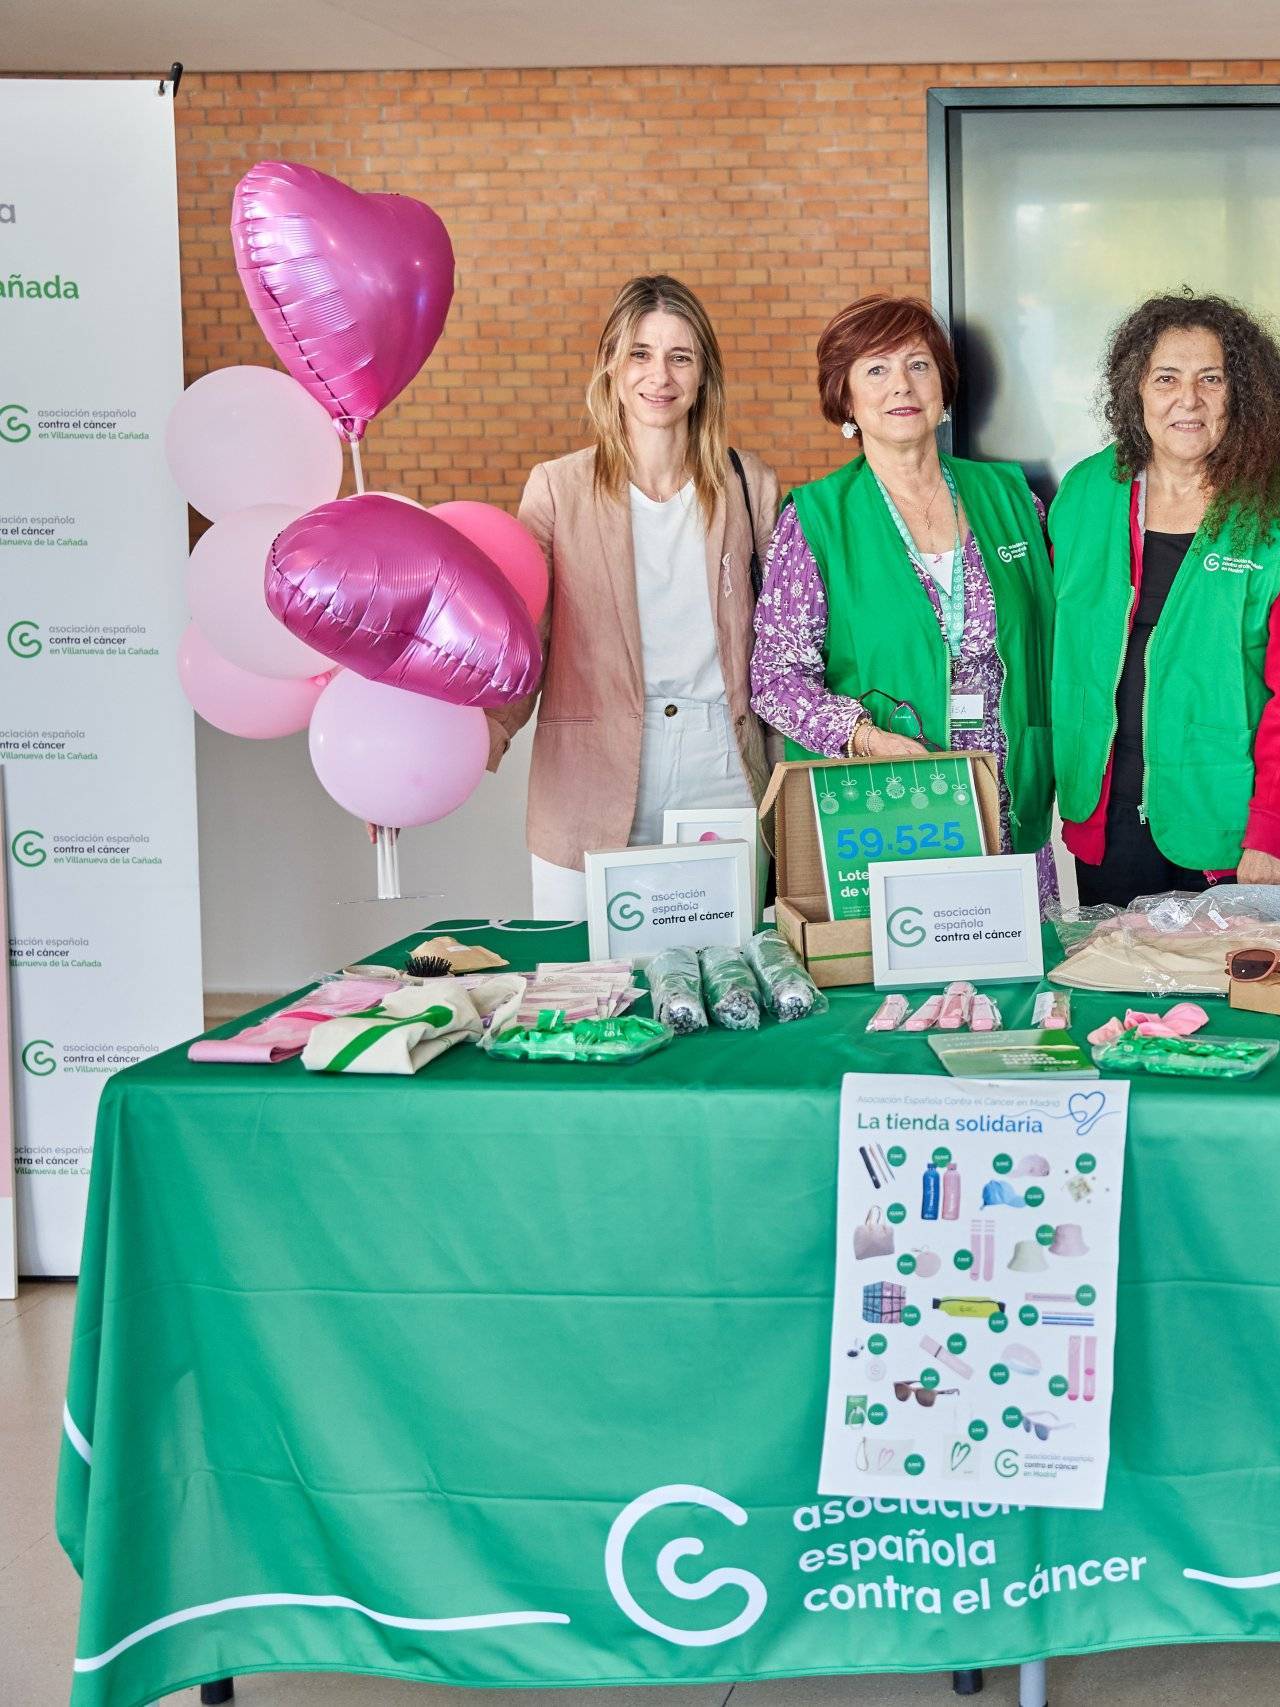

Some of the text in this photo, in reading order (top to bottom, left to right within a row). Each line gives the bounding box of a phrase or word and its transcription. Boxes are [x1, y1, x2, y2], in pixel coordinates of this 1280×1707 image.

[38, 408, 137, 420] asociación española
[38, 420, 117, 429] contra el cáncer
[118, 431, 149, 440] Cañada
[30, 516, 75, 526] española
[10, 527, 19, 535] el
[21, 527, 55, 535] cáncer
[34, 538, 45, 546] de
[46, 538, 55, 546] la
[57, 537, 88, 546] Cañada
[49, 625, 146, 635] asociación española
[49, 636, 126, 645] contra el cáncer
[61, 647, 105, 655] Villanueva
[127, 647, 159, 655] Cañada
[42, 730, 85, 740] española
[22, 740, 30, 749] el
[33, 741, 65, 749] cáncer
[1, 752, 98, 760] Villanueva de la Cañada
[53, 834, 150, 844] asociación española
[837, 821, 965, 860] 59.525
[54, 845, 130, 854] contra el cáncer
[66, 856, 108, 864] Villanueva
[131, 856, 162, 864] Cañada
[651, 889, 706, 902] asociación
[841, 886, 859, 898] de
[652, 902, 699, 914] española
[934, 906, 991, 918] asociación
[652, 910, 735, 926] contra el cáncer
[934, 918, 984, 931] española
[935, 929, 1022, 943] contra el cáncer
[46, 937, 89, 947] española
[26, 949, 35, 957] el
[37, 948, 70, 957] cáncer
[71, 959, 102, 968] Cañada
[63, 1042, 113, 1052] asociación
[63, 1054, 140, 1063] contra el cáncer
[857, 1113, 1043, 1133] La tienda solidaria
[35, 1156, 44, 1164] el
[46, 1156, 78, 1165] cáncer
[58, 1167, 68, 1175] de
[799, 1528, 996, 1573] española
[803, 1555, 1147, 1615] contra el cáncer
